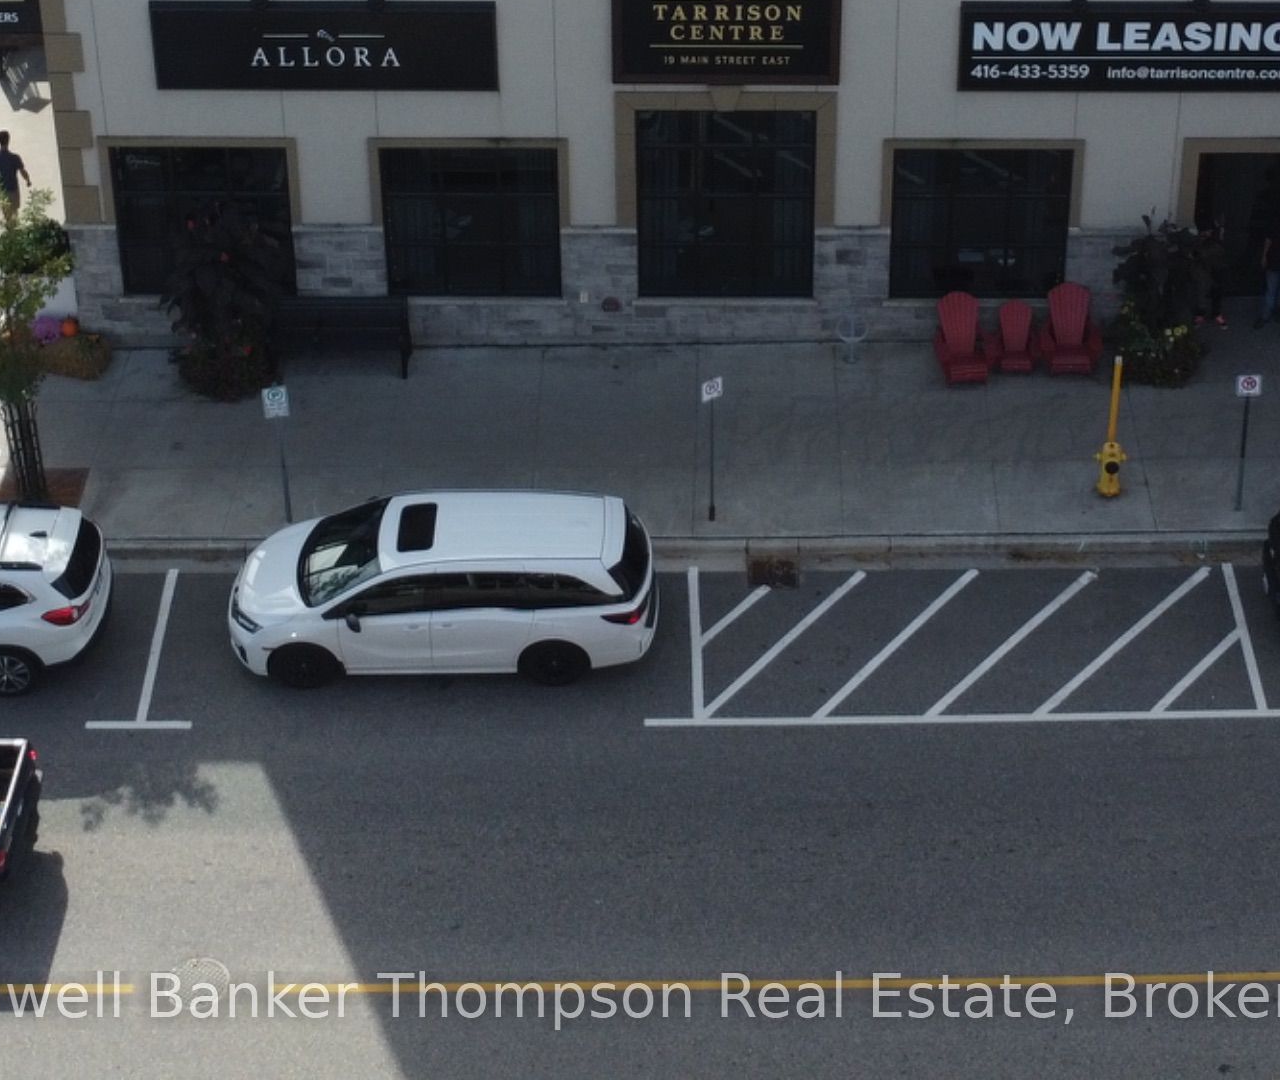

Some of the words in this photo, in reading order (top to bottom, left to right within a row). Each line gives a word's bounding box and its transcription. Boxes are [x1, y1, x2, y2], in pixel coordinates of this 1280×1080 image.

[652, 4, 802, 21] TARRISON
[670, 25, 785, 40] CENTRE
[972, 22, 1082, 51] NOW
[251, 46, 401, 67] ALLORA
[663, 56, 676, 65] 19
[680, 56, 709, 65] MAIN
[715, 56, 756, 65] STREET
[762, 56, 791, 66] EAST
[971, 64, 1090, 79] 416-433-5359
